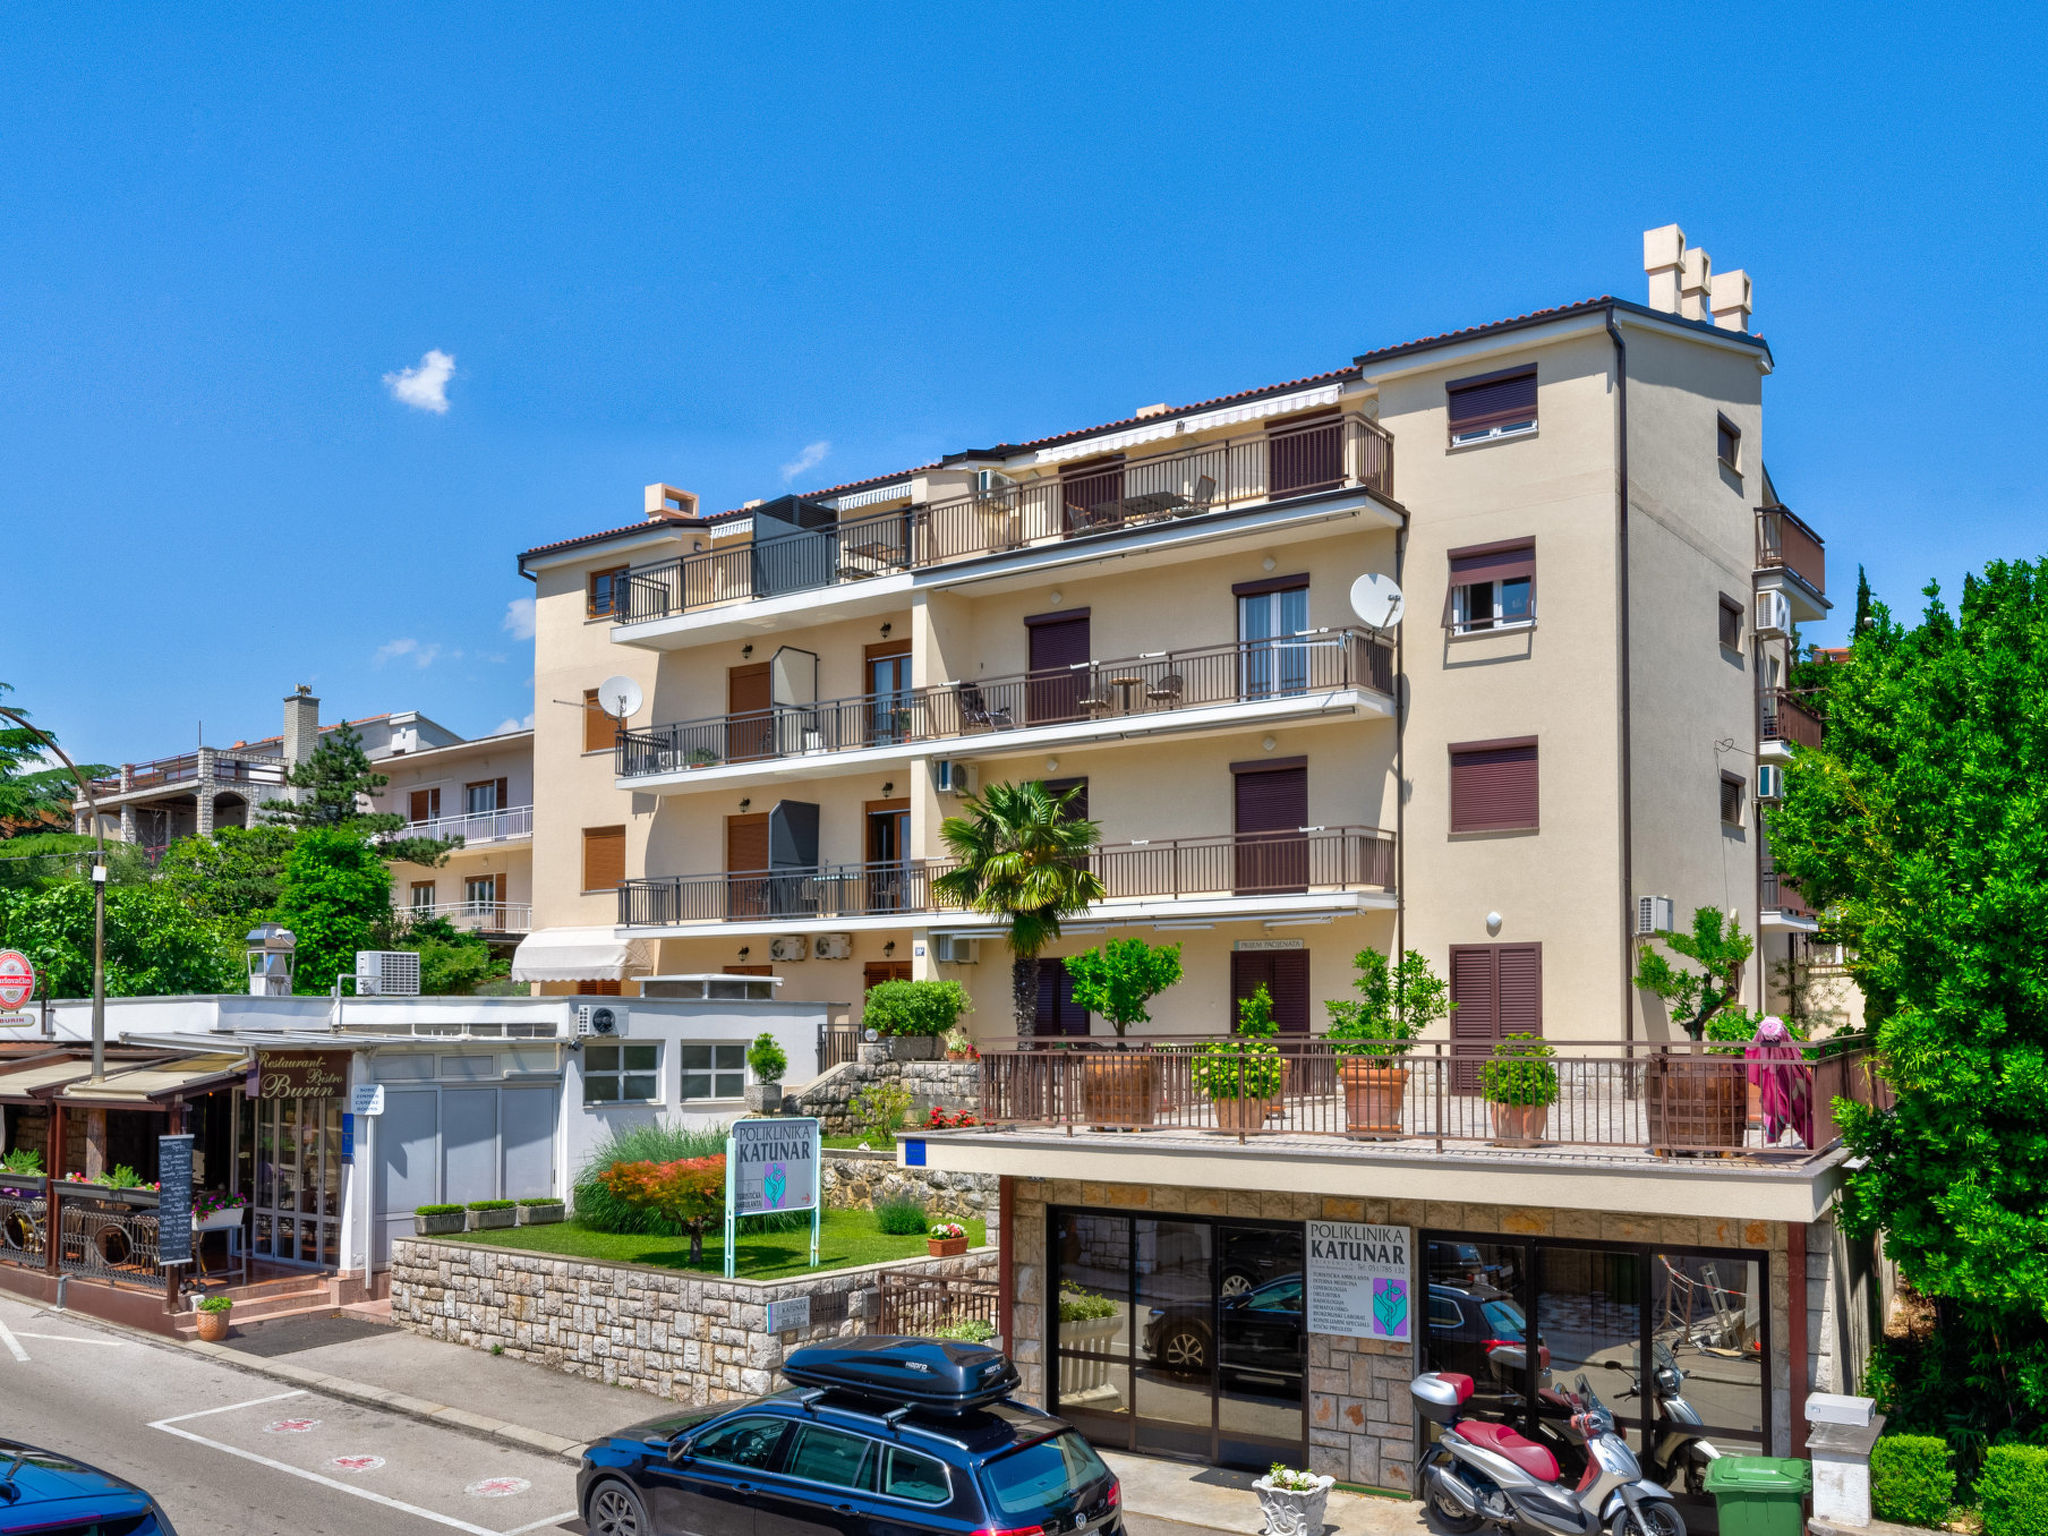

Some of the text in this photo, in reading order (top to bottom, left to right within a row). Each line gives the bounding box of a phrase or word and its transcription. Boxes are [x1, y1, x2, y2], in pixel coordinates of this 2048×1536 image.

[260, 1073, 335, 1099] Burin
[306, 1068, 343, 1085] Bistro
[739, 1125, 811, 1142] POLIKLINIKA
[739, 1141, 811, 1163] KATUNAR
[1310, 1224, 1405, 1244] POLIKLINIKA
[1311, 1239, 1405, 1265] KATUNAR
